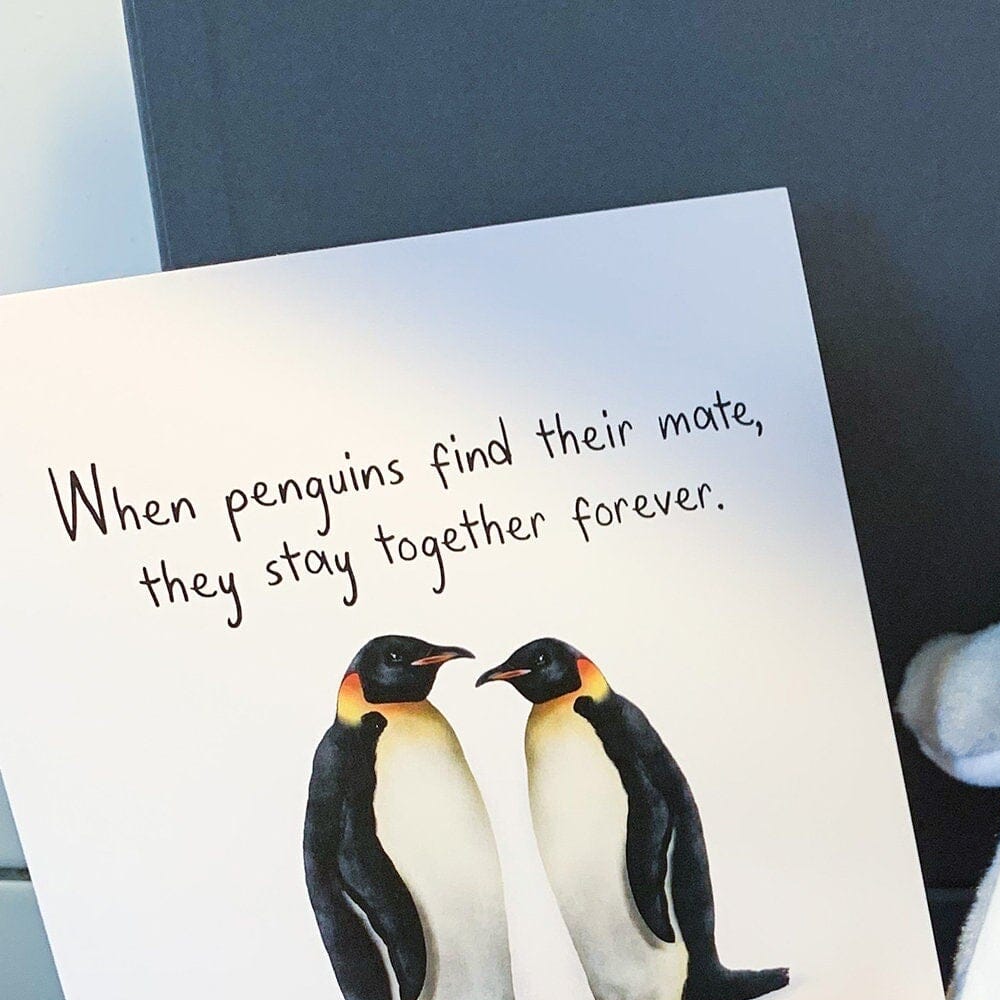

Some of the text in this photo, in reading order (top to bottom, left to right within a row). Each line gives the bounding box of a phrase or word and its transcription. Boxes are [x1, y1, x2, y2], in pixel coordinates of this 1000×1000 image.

[48, 389, 764, 543] When penguins find their mate,
[138, 482, 725, 629] they stay together forever.
